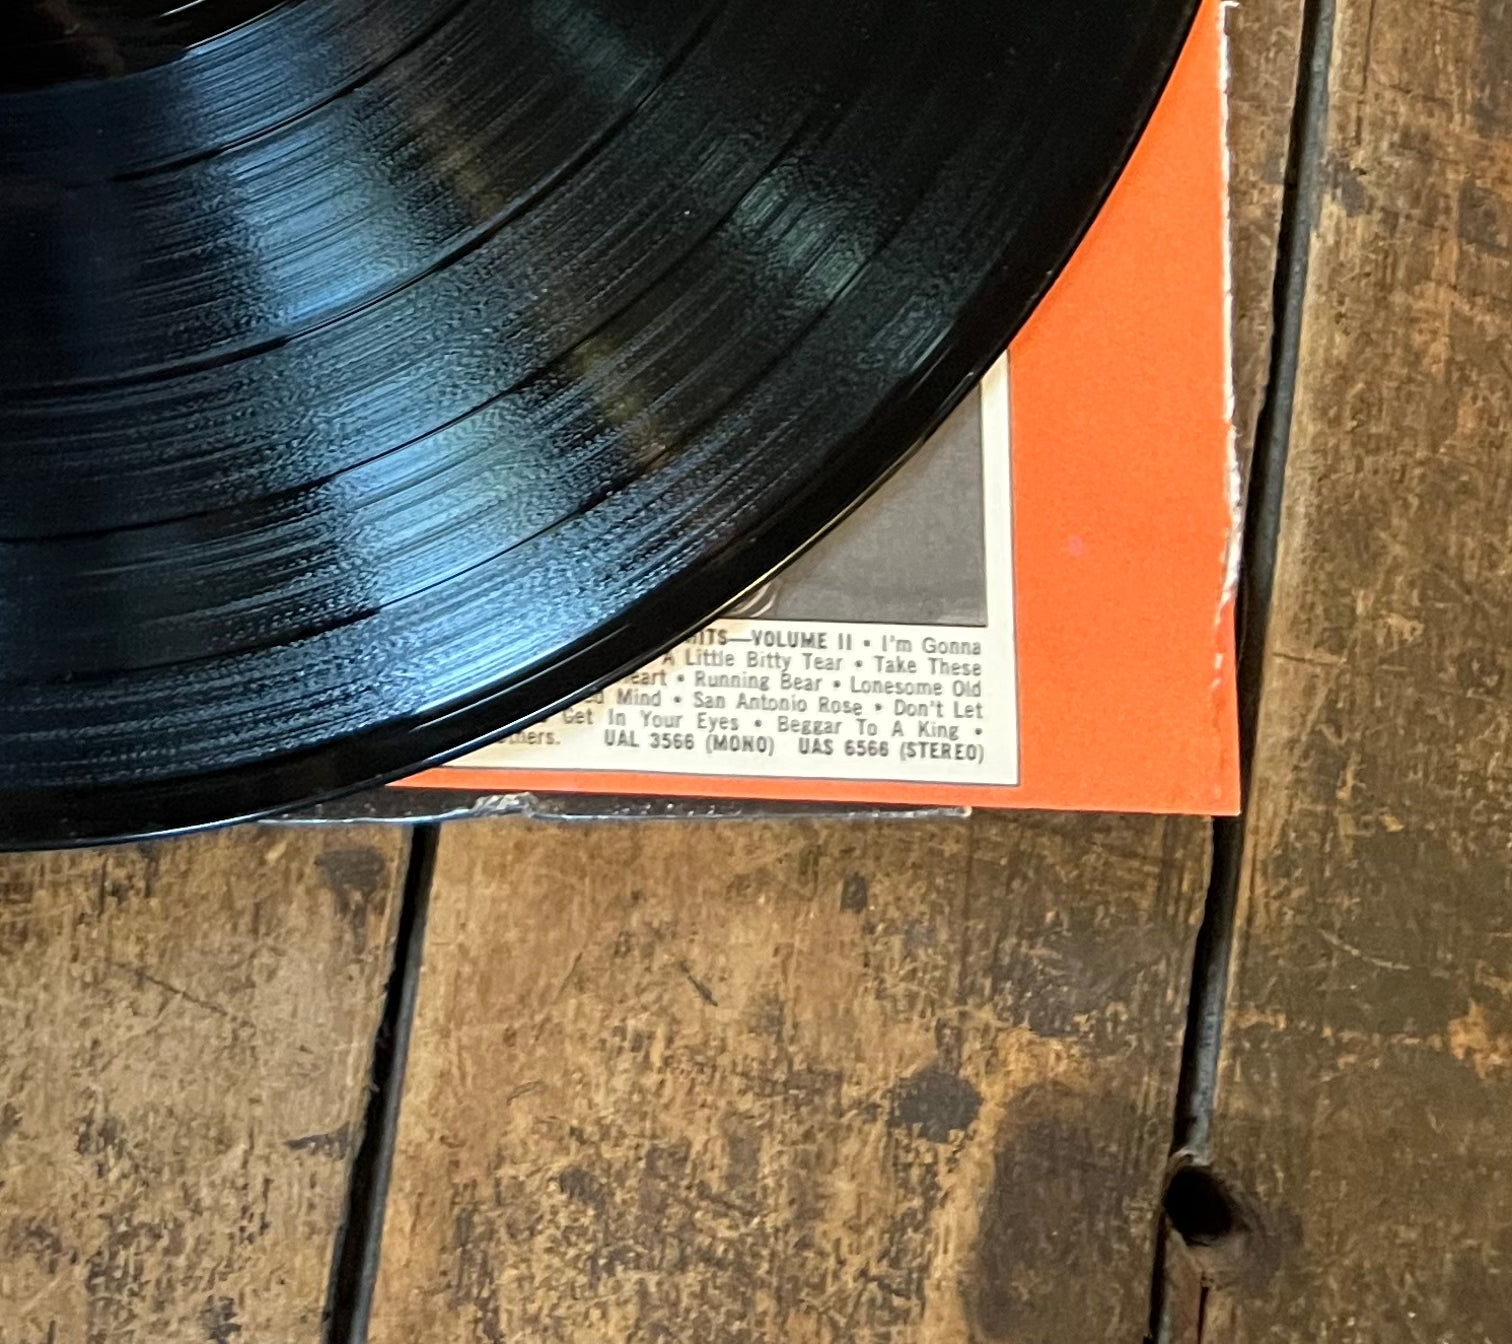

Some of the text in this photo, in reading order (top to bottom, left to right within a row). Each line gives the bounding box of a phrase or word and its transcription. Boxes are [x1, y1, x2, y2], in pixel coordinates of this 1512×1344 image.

[837, 632, 854, 651] II
[881, 634, 913, 653] I'm
[921, 635, 983, 656] Gonna
[684, 649, 736, 668] Little
[745, 650, 792, 672] Bitty
[801, 652, 844, 672] Tear
[873, 654, 918, 674] Take
[927, 656, 983, 677] These
[694, 670, 983, 698] Running Bear Lonesome Old
[616, 687, 662, 707] Mind
[693, 690, 727, 710] San
[736, 692, 808, 713] Antonio
[817, 695, 864, 716] Rose
[893, 698, 945, 719] Don't
[952, 700, 985, 720] Let
[562, 707, 594, 726] Get
[607, 708, 628, 727] In
[639, 709, 684, 729] Your
[696, 712, 740, 733] Eyes
[776, 715, 844, 736] Beggar
[855, 718, 879, 737] To
[890, 720, 905, 738] A
[917, 720, 961, 742] King
[604, 728, 986, 765] UAL 3566 (MONO) UAS 6566 (STEREO)
